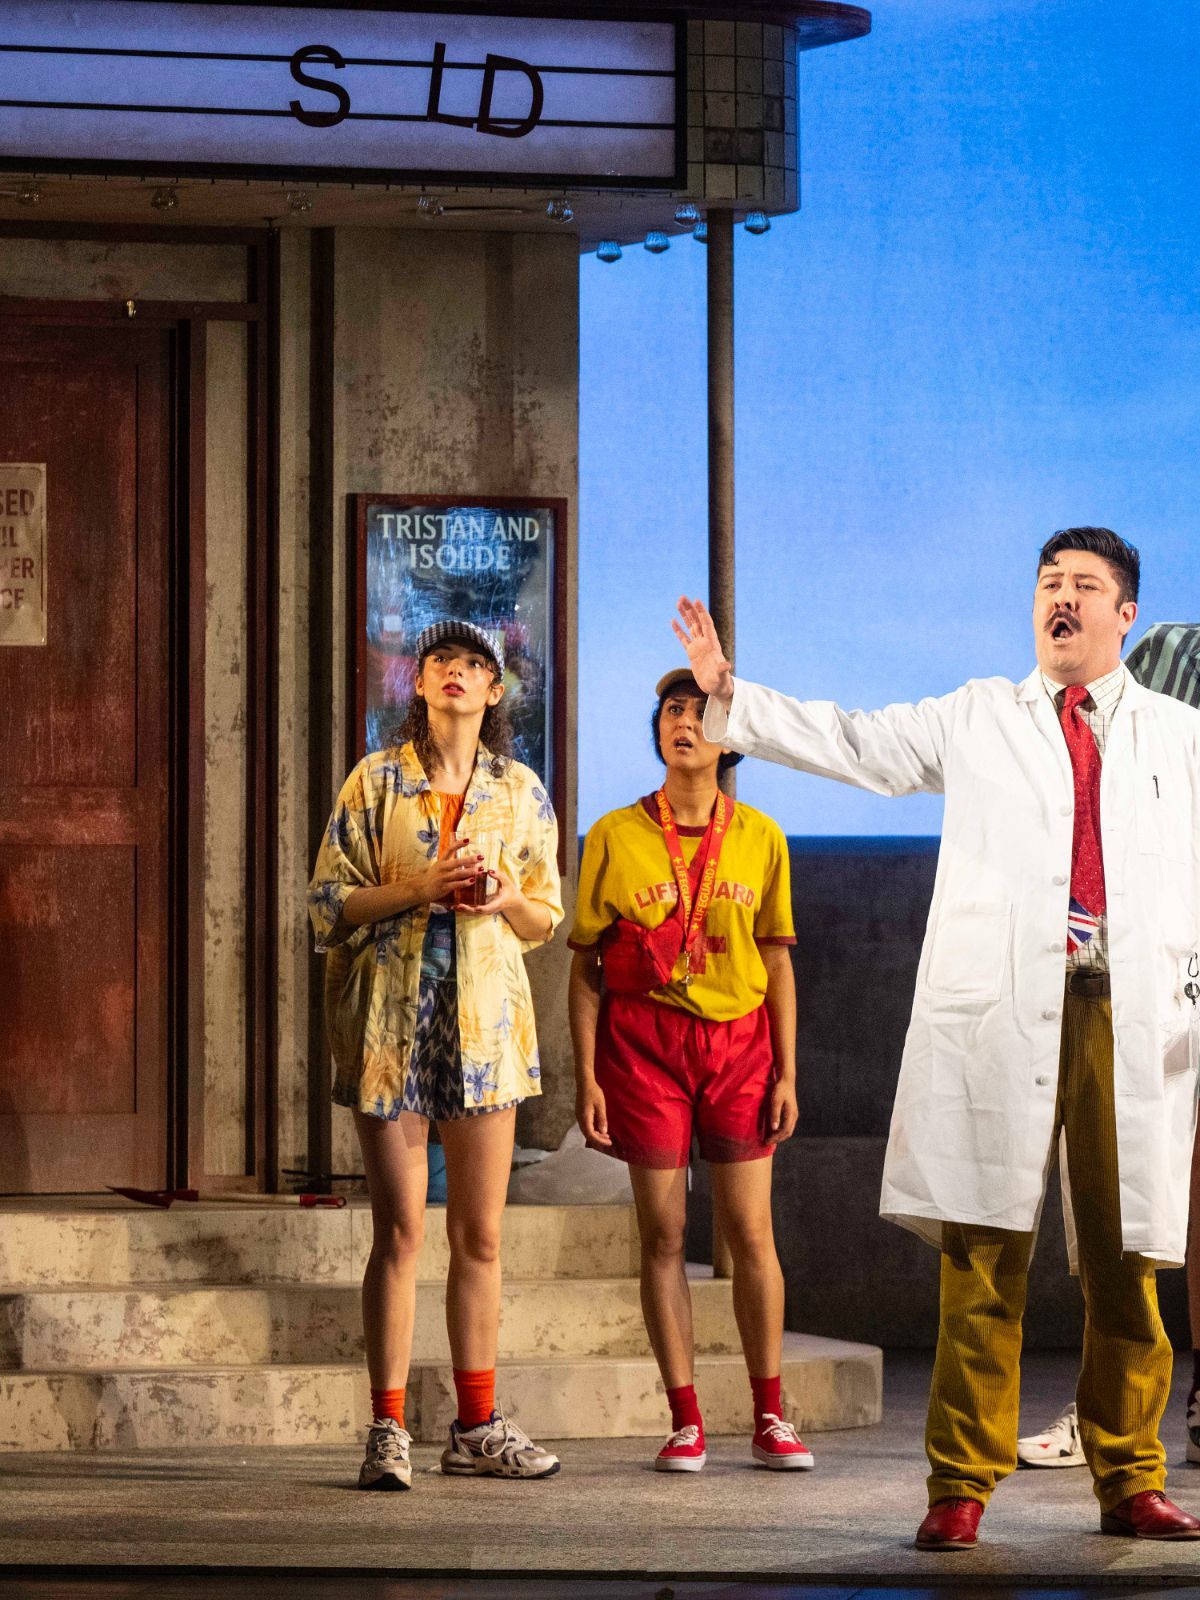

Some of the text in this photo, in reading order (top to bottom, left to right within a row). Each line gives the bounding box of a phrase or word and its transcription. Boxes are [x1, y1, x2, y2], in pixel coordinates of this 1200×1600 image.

[289, 44, 350, 128] S
[376, 513, 540, 542] TRISTAN AND
[409, 543, 511, 571] ISOLDE
[634, 880, 755, 910] LIFEARD
[694, 868, 716, 922] LIFEGUARD
